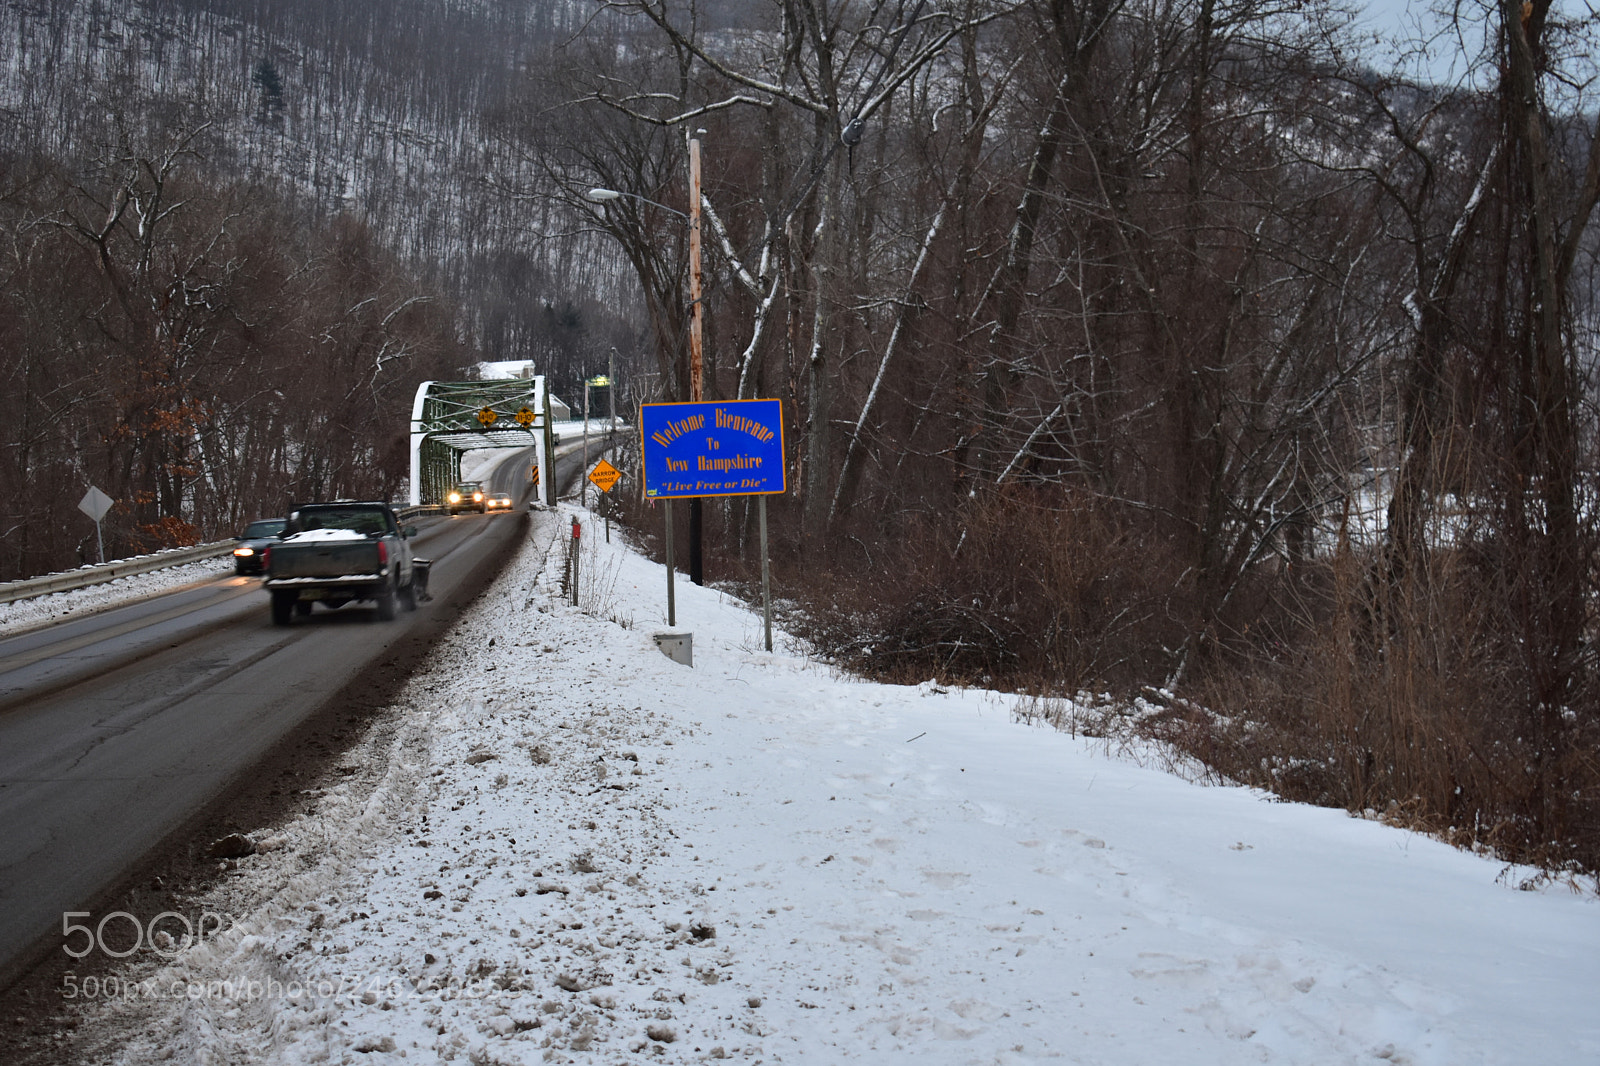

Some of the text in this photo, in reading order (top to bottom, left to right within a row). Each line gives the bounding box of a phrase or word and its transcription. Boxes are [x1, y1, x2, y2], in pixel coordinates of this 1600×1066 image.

[651, 408, 775, 448] Welcome Bienvenue
[706, 437, 720, 451] To
[666, 453, 763, 474] New Hampshire
[662, 478, 767, 492] "Live Free or Die"
